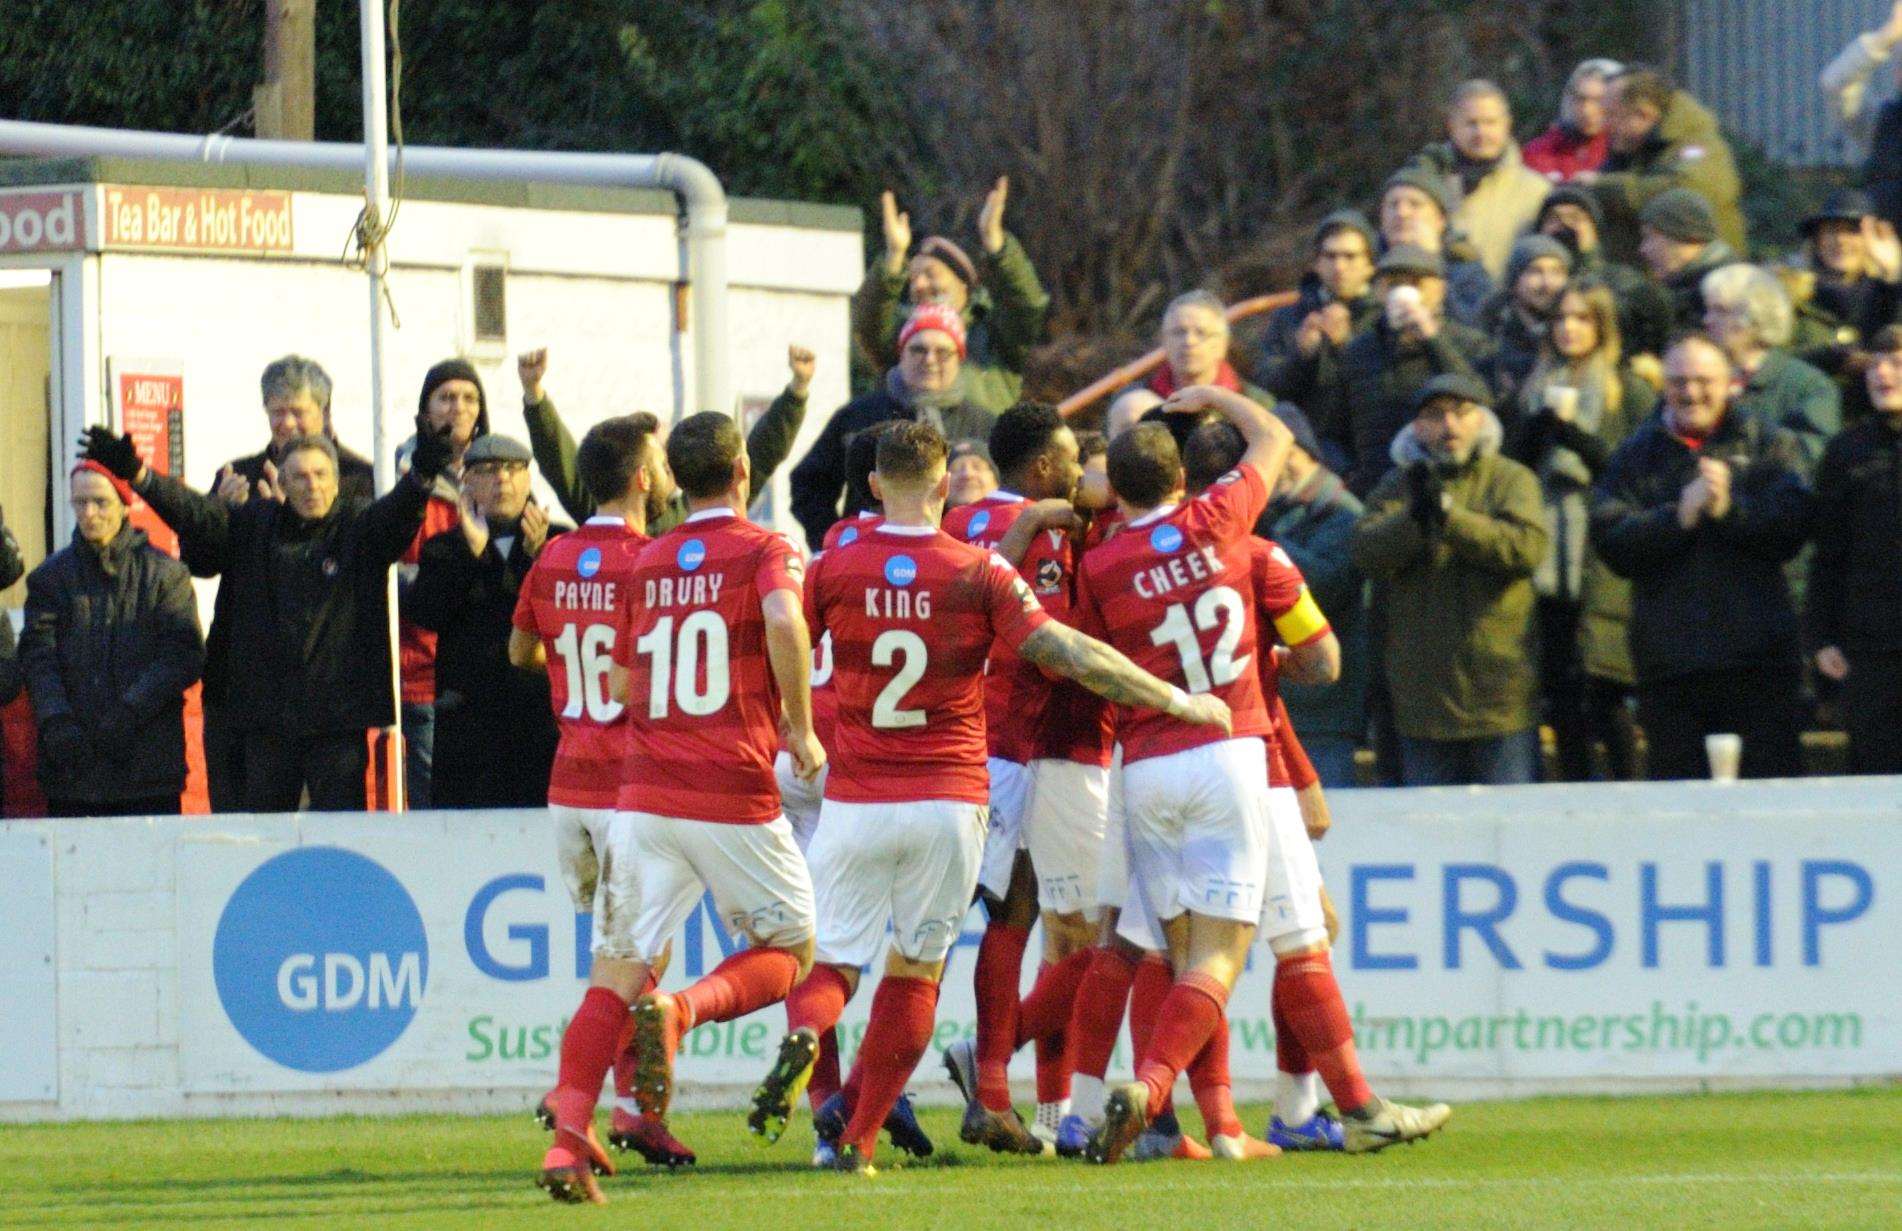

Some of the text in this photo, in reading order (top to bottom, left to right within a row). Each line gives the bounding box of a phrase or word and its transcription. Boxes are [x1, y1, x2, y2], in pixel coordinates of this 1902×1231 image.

[109, 191, 290, 247] Tea Bar & Hot Food
[134, 381, 170, 406] MENU
[555, 580, 616, 611] PAYNE
[645, 572, 723, 609] DRURY
[1133, 545, 1226, 598] CHEEK
[865, 588, 931, 619] KING
[637, 610, 730, 720] 10
[1150, 586, 1251, 694] 12
[555, 623, 626, 723] 16
[871, 630, 928, 728] 2
[276, 950, 422, 1012] GDM
